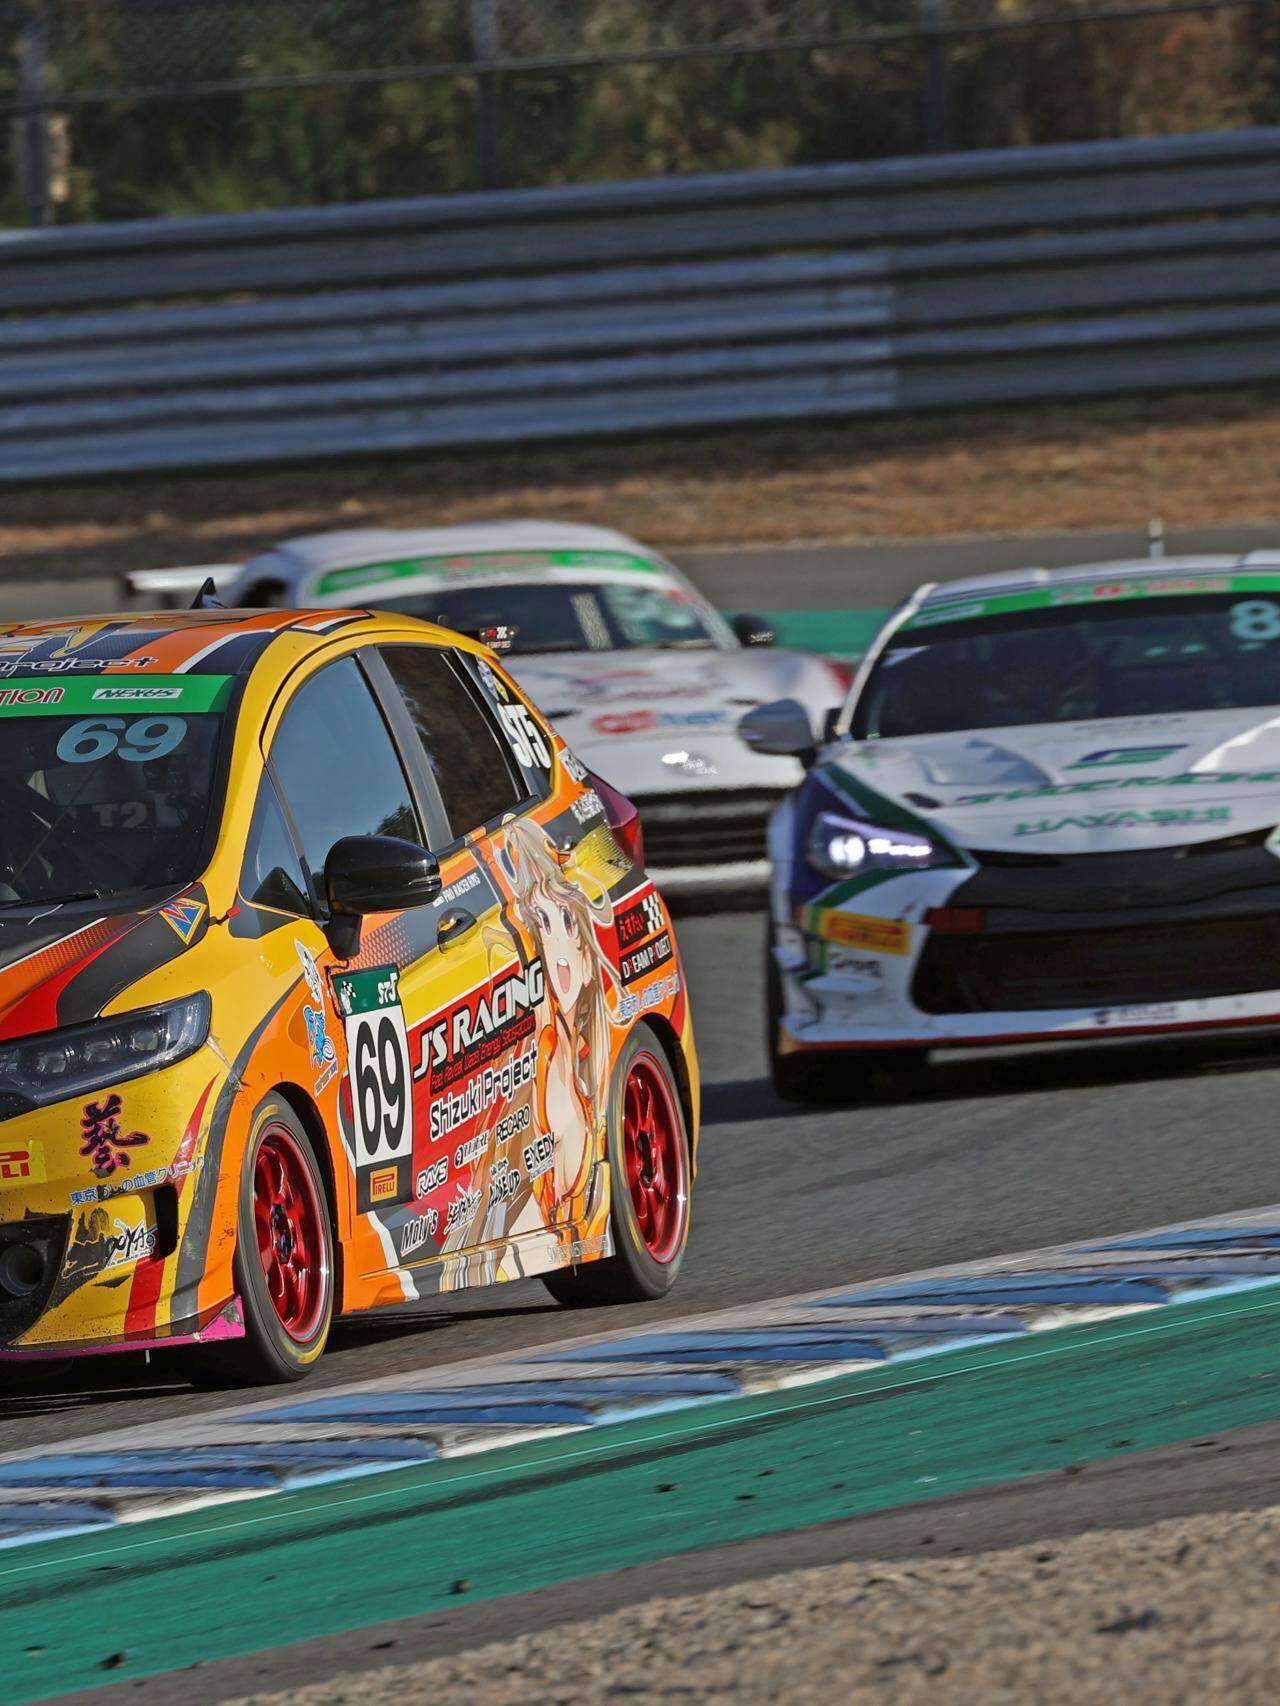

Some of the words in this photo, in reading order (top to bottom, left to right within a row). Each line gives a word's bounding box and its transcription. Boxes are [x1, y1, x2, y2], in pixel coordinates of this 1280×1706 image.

[96, 688, 179, 699] NEXUS
[56, 716, 188, 763] 69
[497, 702, 552, 768] ST5
[377, 971, 398, 1005] ST5
[413, 1018, 448, 1082] J'S
[452, 956, 545, 1056] RACING
[355, 1016, 406, 1156] 69
[429, 1078, 481, 1142] Shizuki
[483, 1039, 538, 1110] Project
[496, 1104, 531, 1146] RECARO
[523, 1133, 555, 1172] EXEDY
[372, 1173, 396, 1195] PIRELLI
[416, 1156, 449, 1199] RAYS
